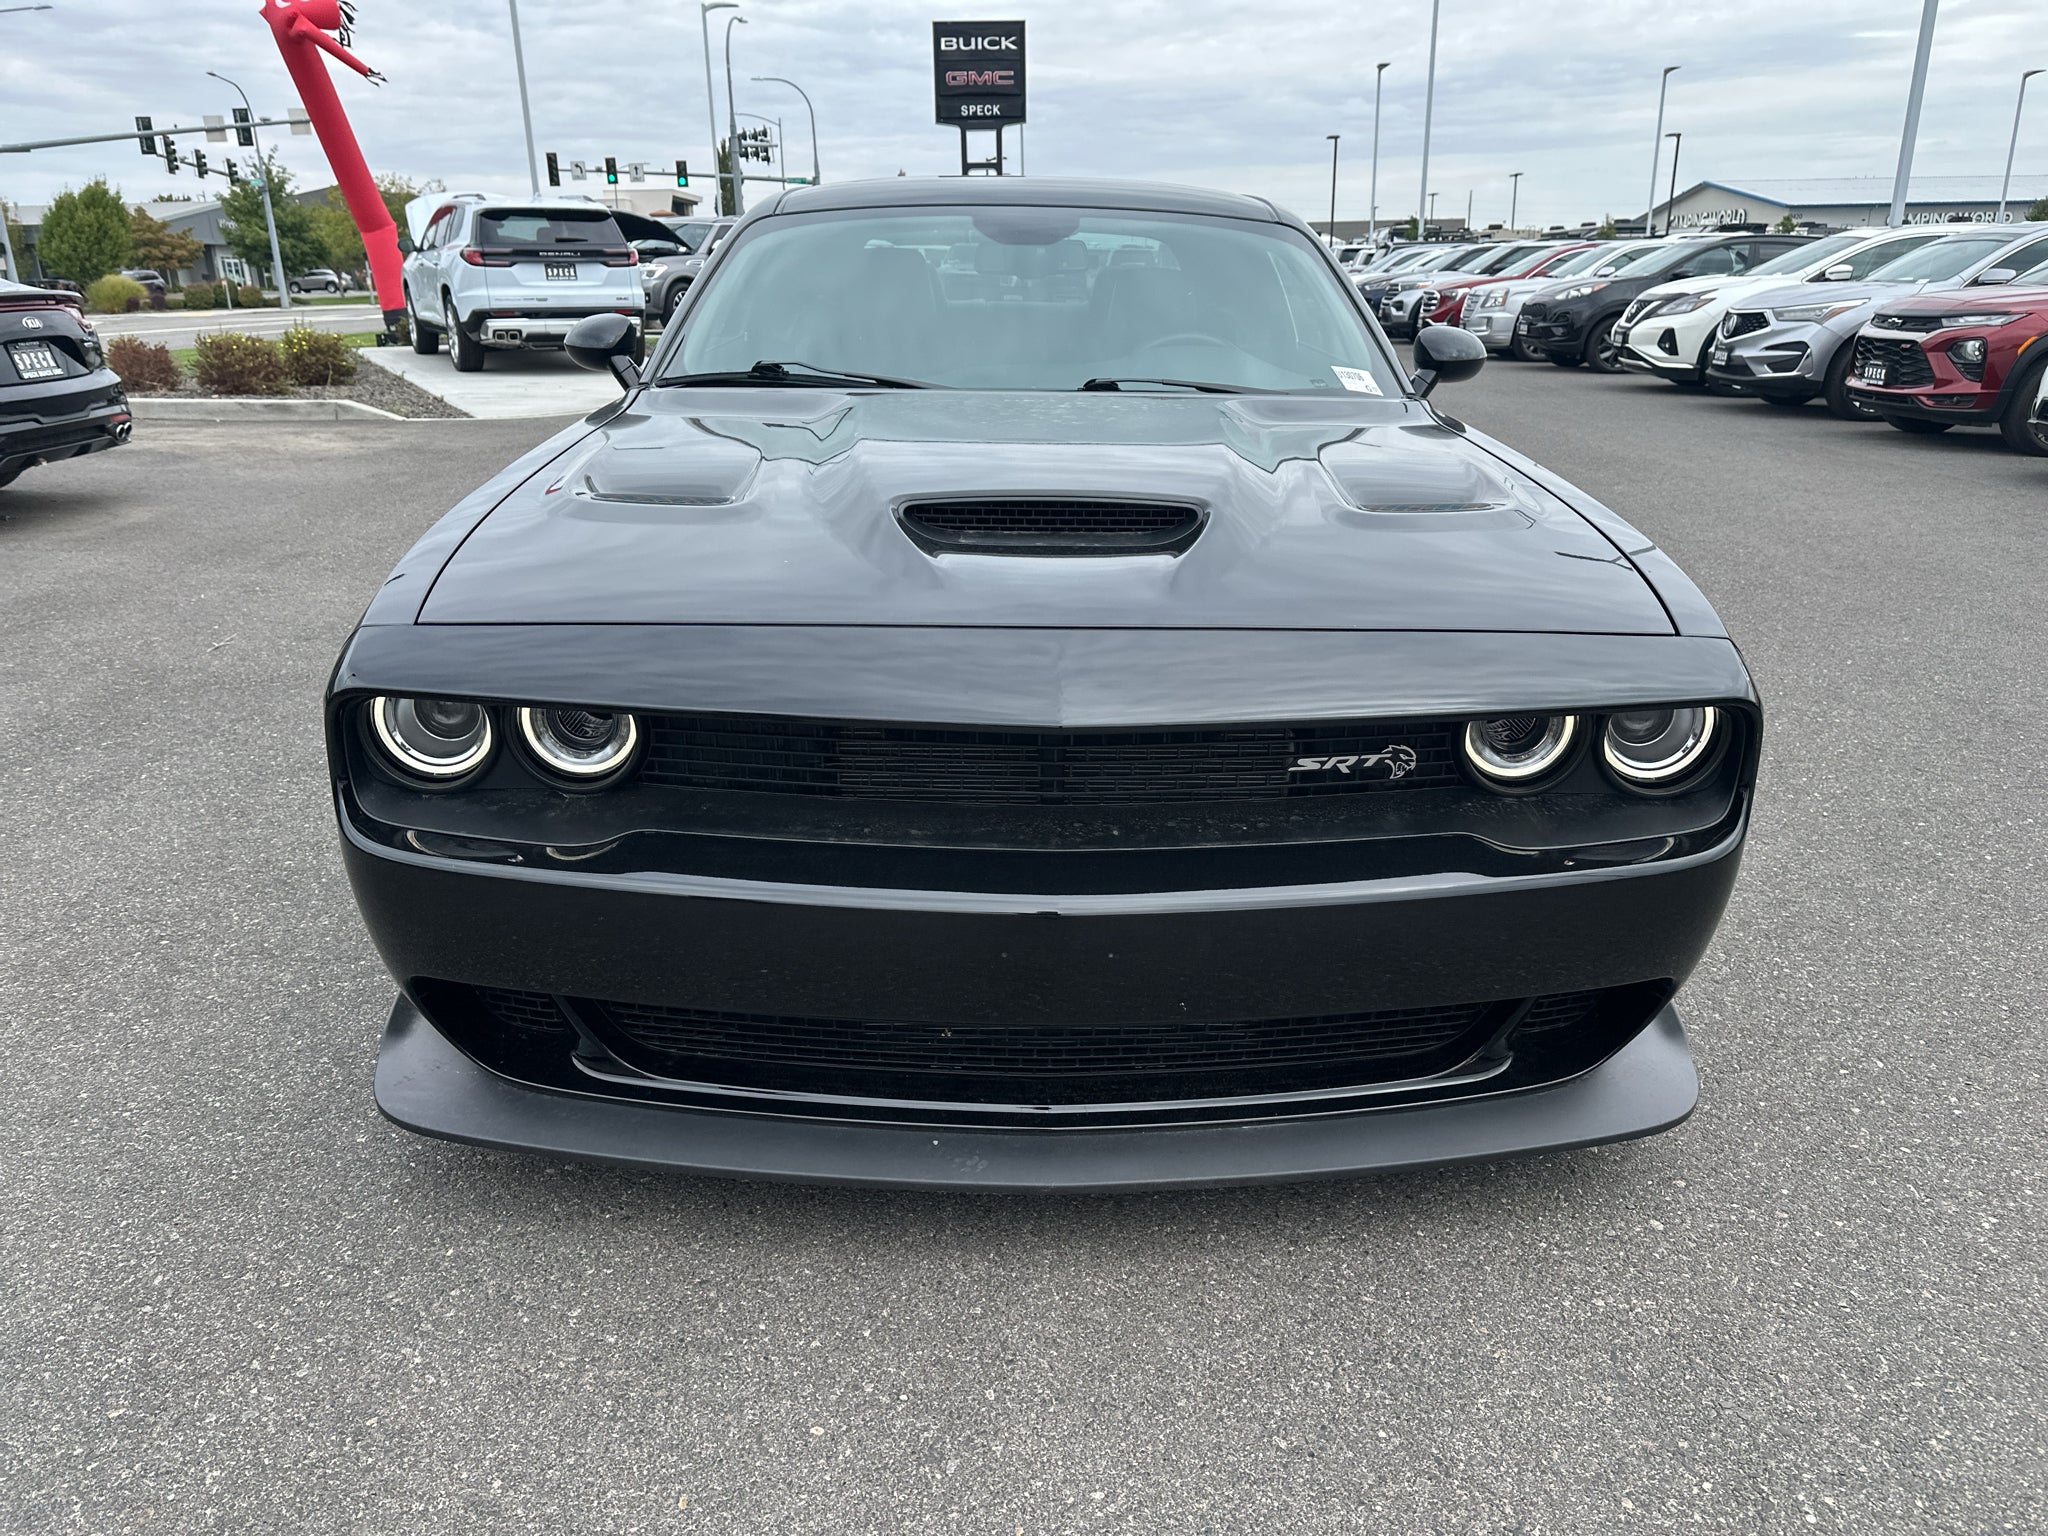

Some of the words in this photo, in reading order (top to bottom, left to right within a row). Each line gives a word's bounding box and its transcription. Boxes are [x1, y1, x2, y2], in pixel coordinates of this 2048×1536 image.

[940, 36, 1018, 51] BUICK
[945, 70, 1014, 86] GMC
[960, 104, 1001, 117] SPECK
[547, 267, 576, 277] SPECK
[26, 318, 42, 329] KIA
[13, 351, 56, 370] SPECK
[1863, 366, 1886, 380] SPECK
[1288, 753, 1392, 774] SRT
